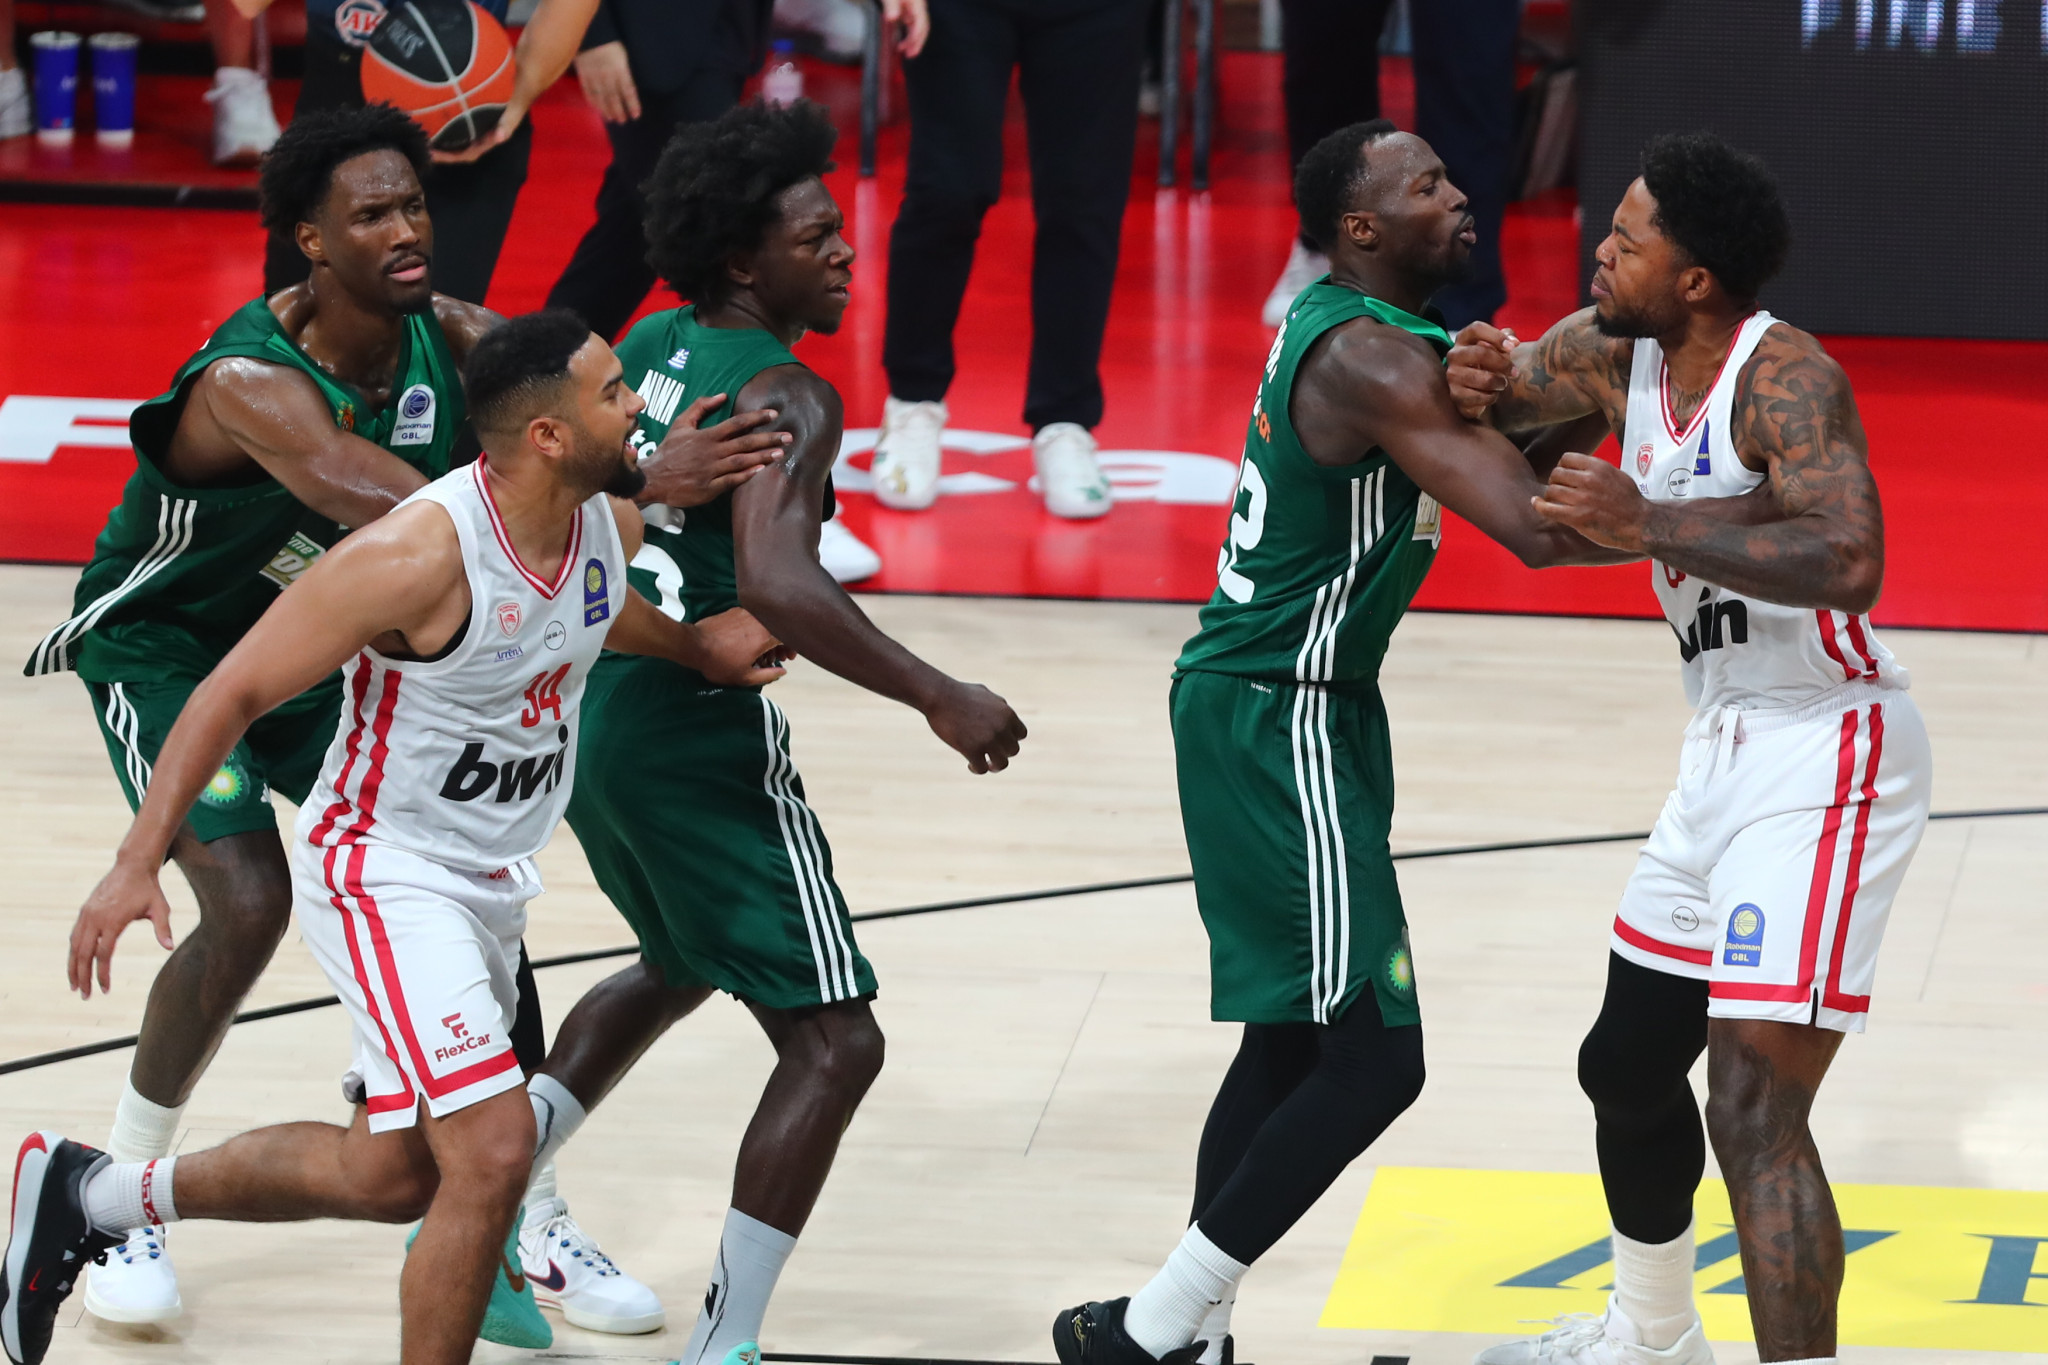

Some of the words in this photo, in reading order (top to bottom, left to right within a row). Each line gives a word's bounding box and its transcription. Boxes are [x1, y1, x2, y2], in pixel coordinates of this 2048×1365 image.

[401, 432, 420, 440] GBL
[590, 609, 603, 620] GBL
[1731, 952, 1749, 962] GBL
[434, 1033, 491, 1062] FlexCar
